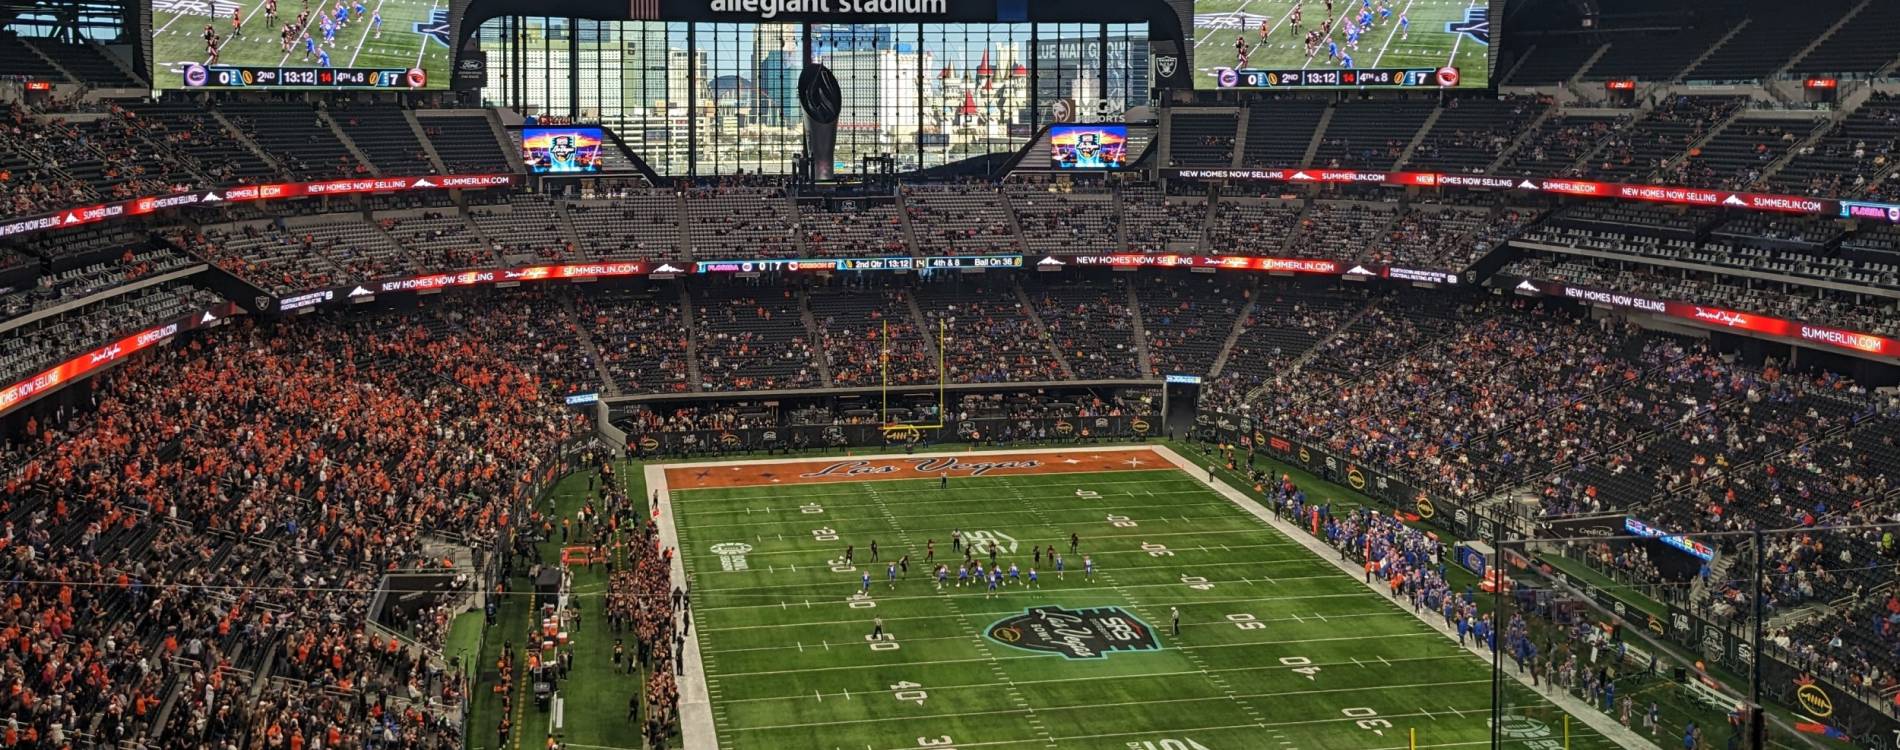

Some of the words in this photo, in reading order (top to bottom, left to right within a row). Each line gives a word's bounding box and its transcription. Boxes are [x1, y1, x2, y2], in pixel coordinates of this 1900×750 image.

[710, 0, 830, 18] allegiant
[838, 0, 947, 13] stadium
[1028, 44, 1056, 59] UE
[219, 73, 229, 84] 0
[257, 71, 275, 83] 2ND
[284, 72, 314, 83] 13:12
[320, 73, 332, 82] 14
[337, 73, 350, 83] 4TH
[357, 73, 364, 82] 8
[390, 74, 398, 84] 7
[1248, 75, 1257, 85] 0
[1282, 74, 1299, 83] 2ND
[1307, 73, 1335, 83] 13:12
[1343, 73, 1354, 82] 14
[1360, 73, 1374, 82] 4TH
[1381, 73, 1388, 82] 8
[1417, 73, 1426, 84] 7
[1077, 114, 1126, 123] ORTS
[1179, 170, 1198, 179] NEW
[1200, 170, 1228, 179] HOMES
[1229, 170, 1249, 179] NOW
[1251, 170, 1283, 179] SELLING
[1321, 172, 1385, 182] SUMMERLIN.COM
[1416, 175, 1434, 183] NEW
[1437, 176, 1461, 184] HOMES
[1462, 177, 1481, 185] NOW
[1482, 178, 1512, 187] SELLING
[308, 184, 324, 193] NEW
[326, 183, 351, 192] HOMES
[353, 182, 373, 190] NOW
[374, 180, 406, 189] SELLING
[443, 177, 508, 187] SUMMERLIN.COM
[1542, 181, 1595, 193] SUMMERLIN.COM
[167, 197, 178, 206] NOW
[178, 194, 198, 204] SELLING
[1622, 187, 1638, 197] NEW
[1640, 189, 1664, 199] HOMES
[1665, 190, 1685, 200] NOW
[1686, 191, 1717, 202] SELLING
[1753, 198, 1822, 211] SUMMERLIN.COM
[5, 222, 24, 235] HOMES
[24, 219, 39, 231] NOW
[39, 215, 61, 228] SELLING
[855, 260, 869, 268] 2nd
[870, 260, 882, 268] Qtr
[974, 258, 989, 266] Ball
[990, 258, 1001, 266] On
[1076, 256, 1097, 264] NEW
[1099, 256, 1130, 265] HOMES
[1132, 256, 1154, 265] NOW
[1156, 256, 1193, 265] SELLING
[1262, 260, 1334, 271] SUMMERLIN.COM
[563, 264, 639, 277] SUMMERLIN.COM
[382, 282, 401, 291] NEW
[403, 278, 433, 289] HOMES
[435, 276, 455, 286] NOW
[457, 272, 494, 284] SELLING
[1565, 287, 1582, 298] NEW
[1584, 290, 1611, 302] HOMES
[1612, 294, 1631, 306] NOW
[1633, 297, 1665, 313] SELLING
[137, 324, 177, 345] SUMMERLIN.COM
[1801, 327, 1881, 350] SUMMERLIN.COM
[0, 388, 17, 405] OMES
[19, 381, 34, 398] NOW
[34, 370, 58, 390] SELLING
[1271, 437, 1290, 452] ESPN
[800, 460, 899, 478] Las
[905, 457, 1043, 476] Vegas
[811, 528, 839, 541] 20
[1141, 543, 1174, 557] 30
[1180, 576, 1215, 590] 40
[1035, 608, 1083, 629] Las
[1226, 613, 1266, 630] 50
[1030, 623, 1052, 641] BOWL
[1099, 616, 1141, 641] SRS
[1050, 626, 1097, 657] Vegas
[1279, 656, 1321, 676] 40
[890, 681, 928, 700] 40
[1341, 707, 1392, 731] 30
[917, 735, 957, 750] 3
